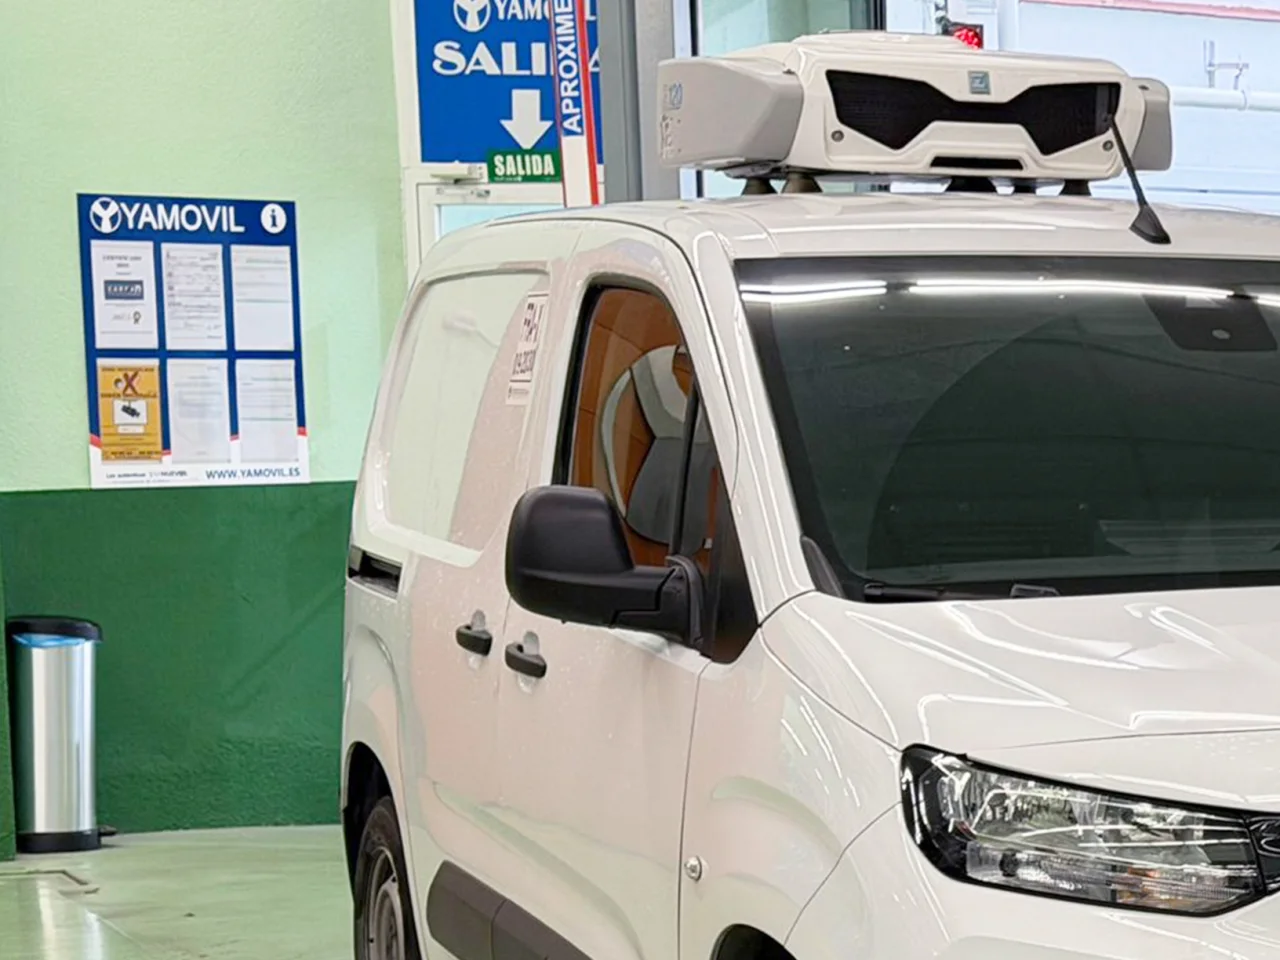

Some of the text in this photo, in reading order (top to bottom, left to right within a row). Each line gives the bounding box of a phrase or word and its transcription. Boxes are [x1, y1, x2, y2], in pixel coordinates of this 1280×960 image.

[493, 154, 556, 176] SALIDA
[120, 203, 246, 233] YAMOVIL
[205, 467, 301, 480] WWW.YAMOVIL.ES
